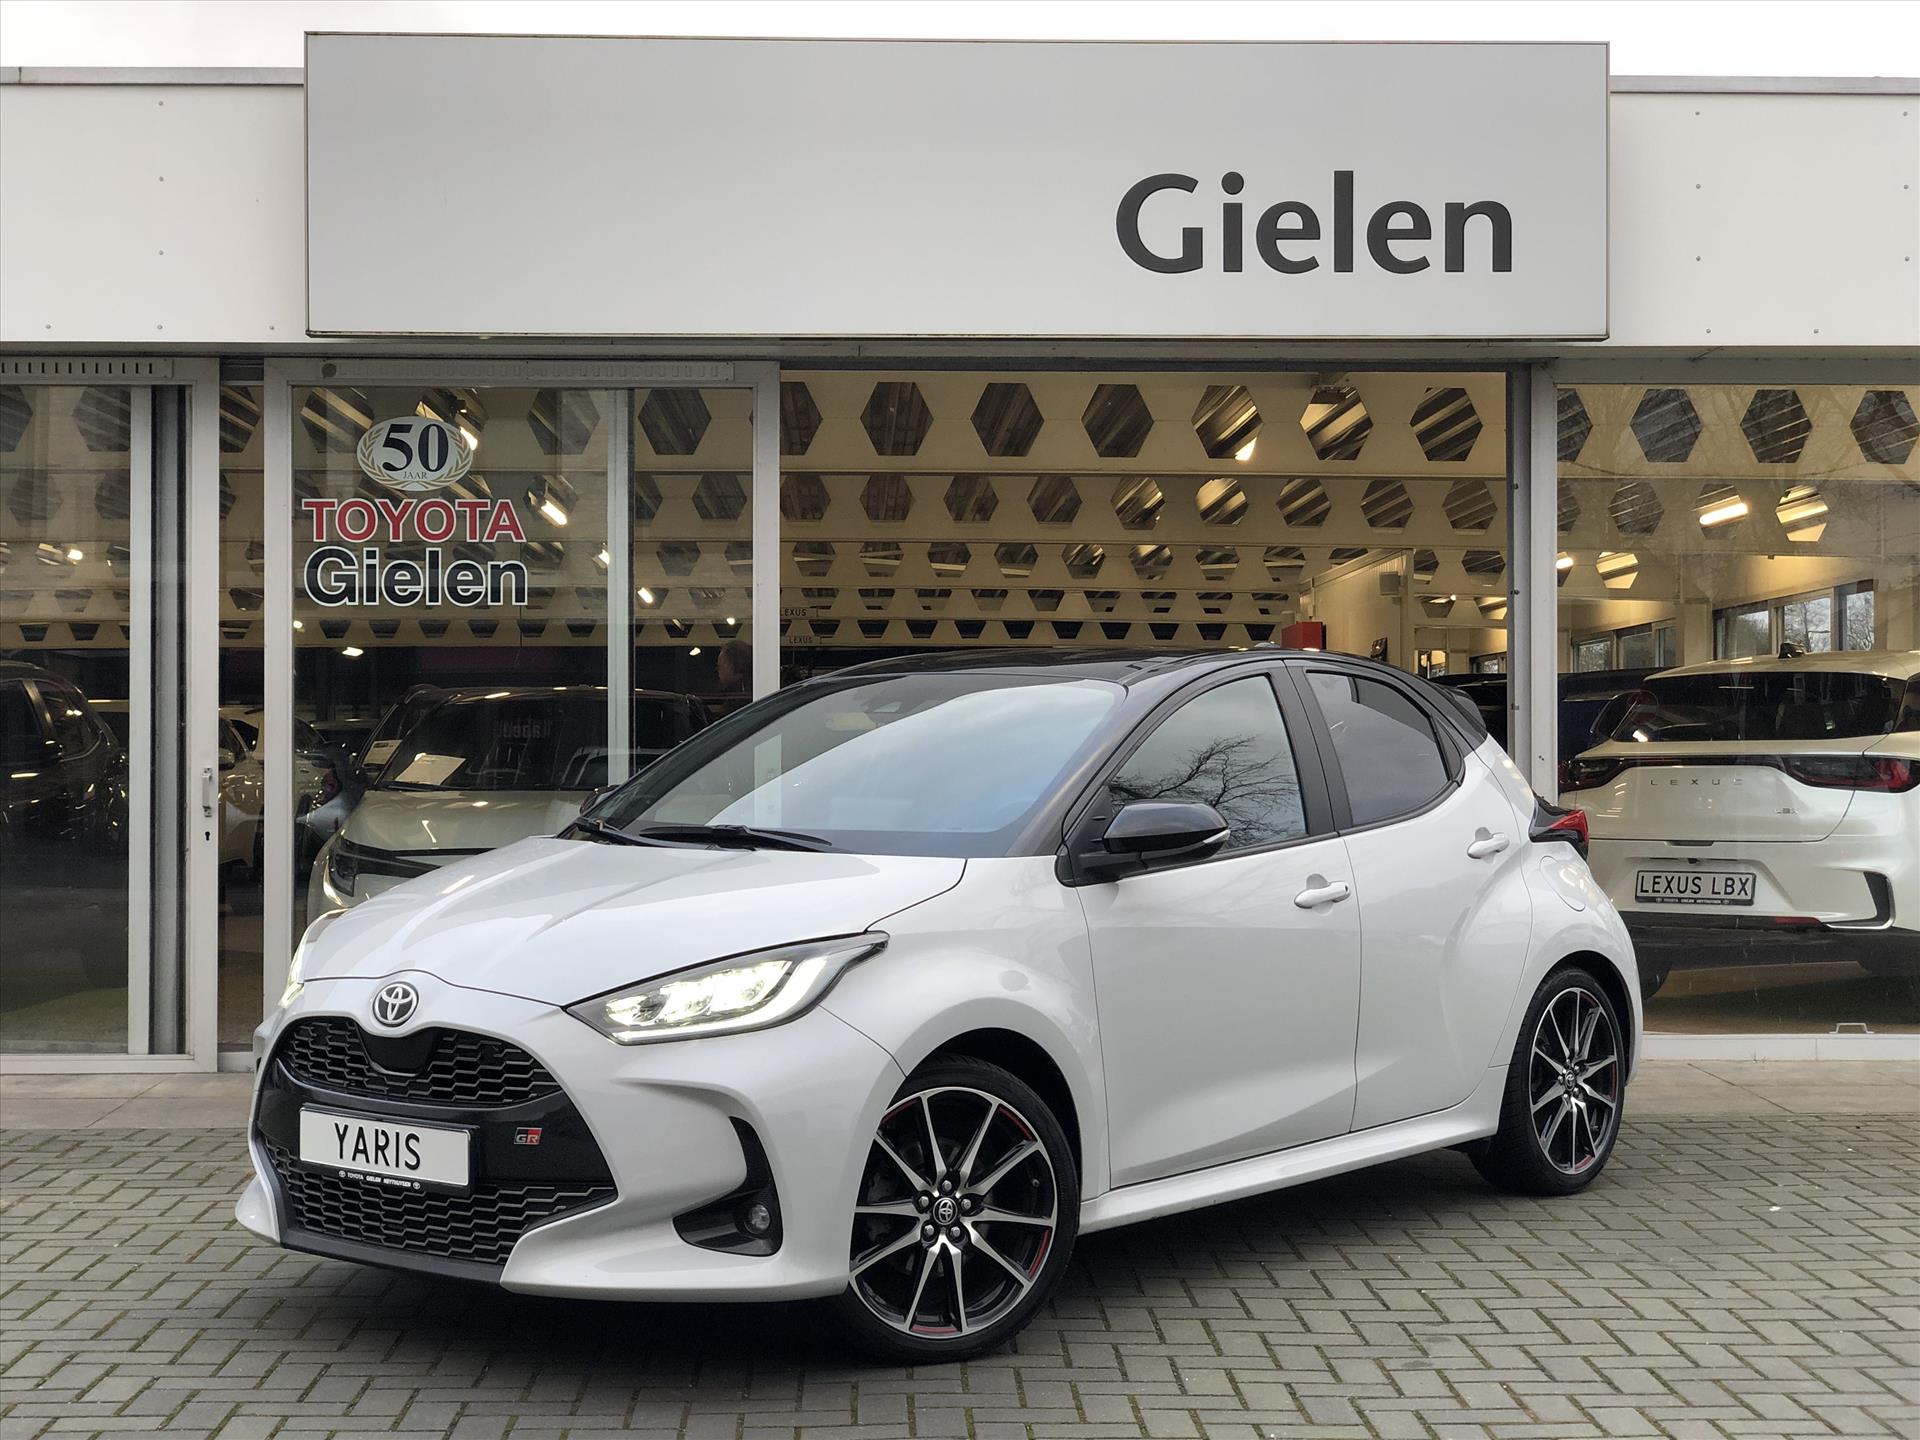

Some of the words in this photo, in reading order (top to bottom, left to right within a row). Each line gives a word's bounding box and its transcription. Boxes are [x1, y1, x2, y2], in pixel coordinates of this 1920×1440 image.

[1116, 170, 1513, 274] Gielen
[382, 423, 449, 472] 50
[402, 471, 428, 480] JAAR
[302, 498, 527, 542] TOYOTA
[304, 546, 528, 606] Gielen
[1640, 875, 1702, 895] LEXUS
[1711, 877, 1750, 897] LBX
[334, 1122, 420, 1170] YARIS
[516, 1134, 538, 1143] GR
[347, 1172, 364, 1180] TOYOTA
